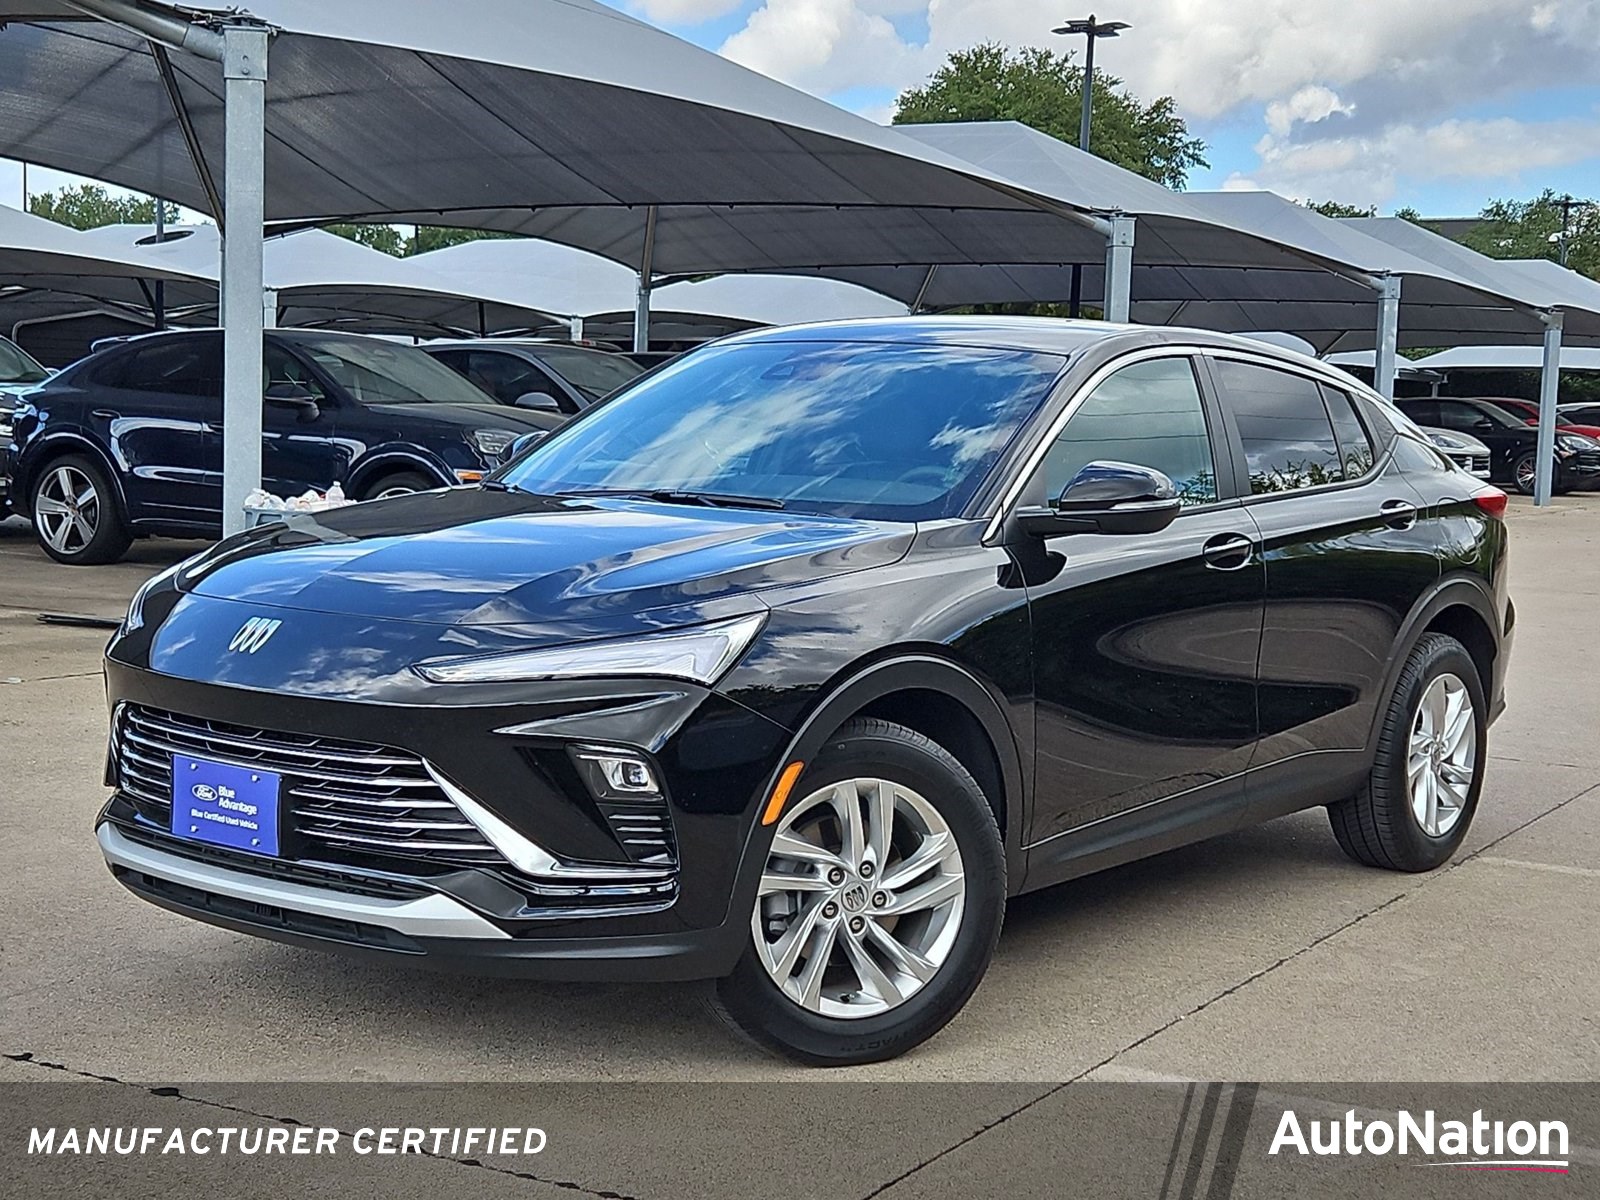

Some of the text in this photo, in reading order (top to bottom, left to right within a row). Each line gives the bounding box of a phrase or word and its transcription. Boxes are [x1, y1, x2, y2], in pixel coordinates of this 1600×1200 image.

[218, 785, 236, 799] Blue
[218, 797, 258, 815] Advantage
[203, 811, 225, 823] Certified
[225, 816, 239, 826] Used
[239, 819, 258, 830] Vehicle
